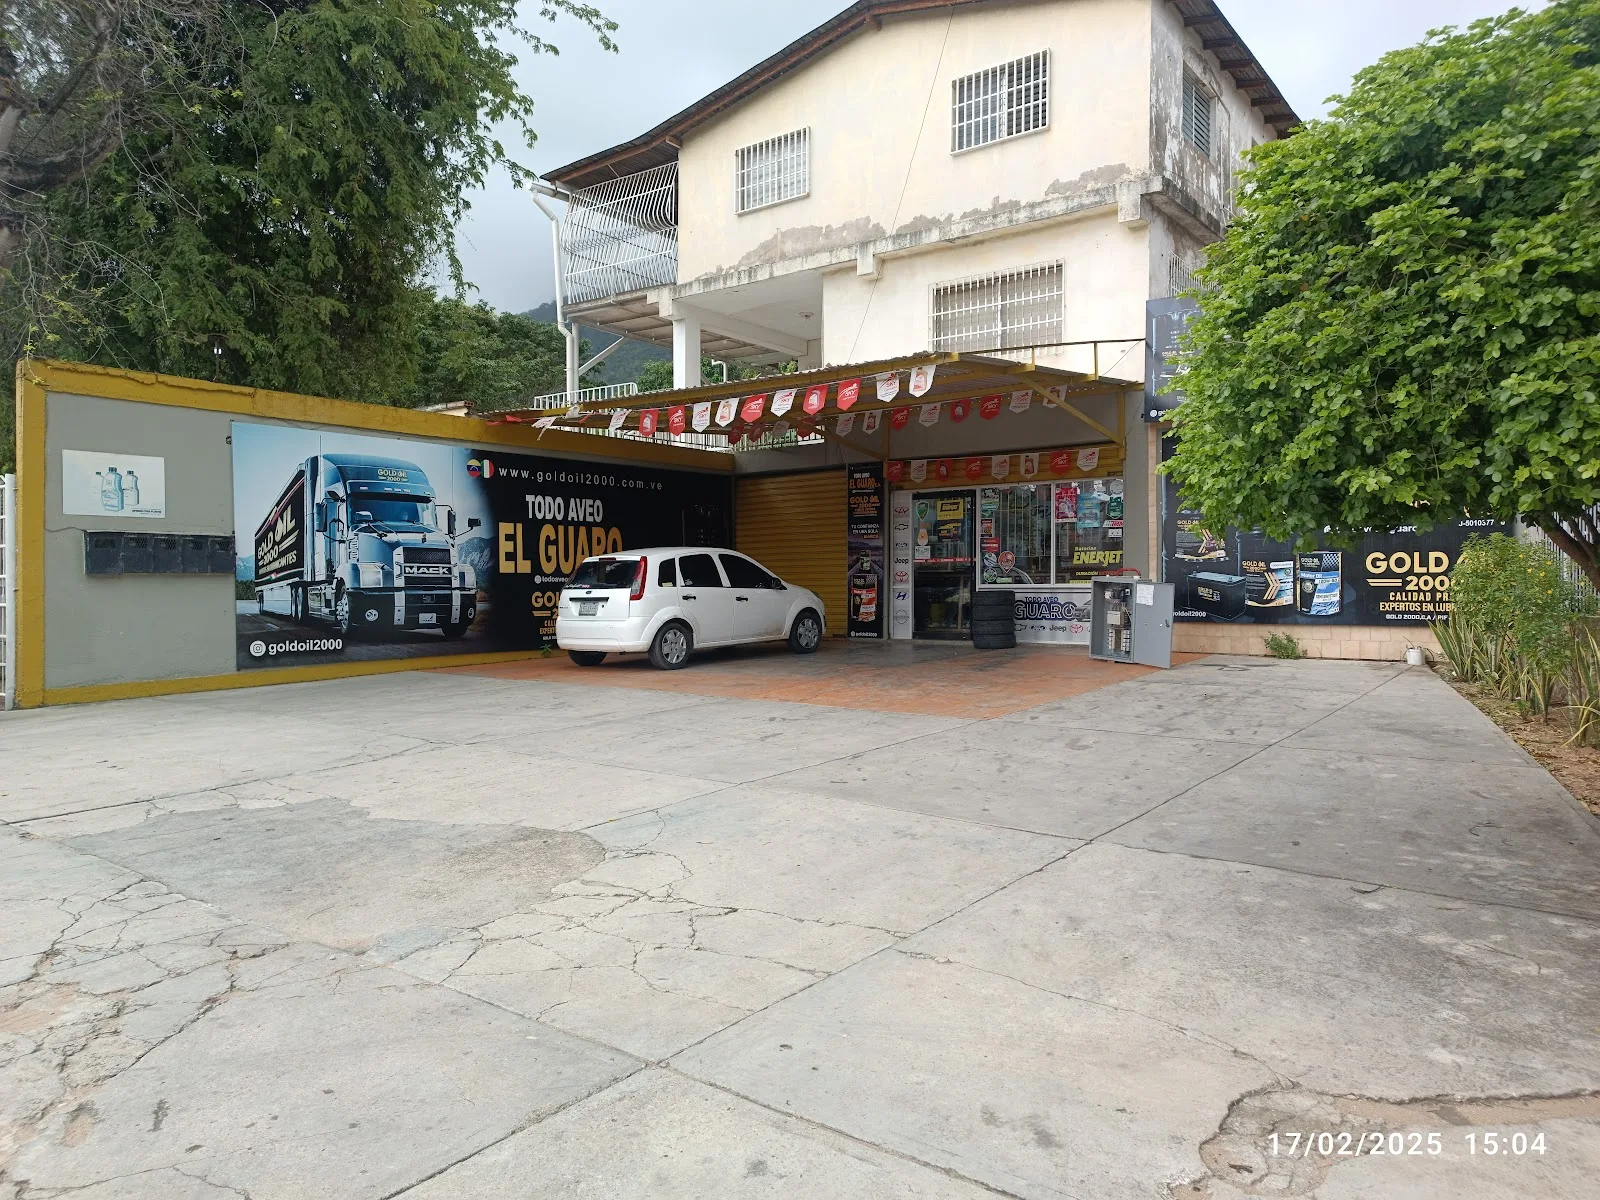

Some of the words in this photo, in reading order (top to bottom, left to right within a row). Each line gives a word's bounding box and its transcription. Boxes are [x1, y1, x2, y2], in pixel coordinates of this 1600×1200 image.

[377, 469, 397, 477] GOLD
[499, 467, 663, 490] www.goldoil2000.com.ve
[525, 494, 565, 521] TODO
[567, 498, 604, 523] AVEO
[257, 531, 274, 560] GOLD
[274, 504, 296, 543] OIL
[498, 522, 532, 574] EL
[1073, 550, 1123, 567] ENERJET
[1365, 551, 1450, 574] GOLD
[404, 566, 449, 574] MACK
[531, 591, 560, 608] GOL
[1389, 592, 1431, 601] CALIDAD
[1014, 601, 1076, 619] GUARO
[1172, 610, 1207, 618] oldoil2000
[1380, 602, 1421, 611] EXPERTOS
[1422, 602, 1434, 611] EN
[1049, 624, 1067, 632] Jeep
[268, 638, 343, 656] goldoil2000
